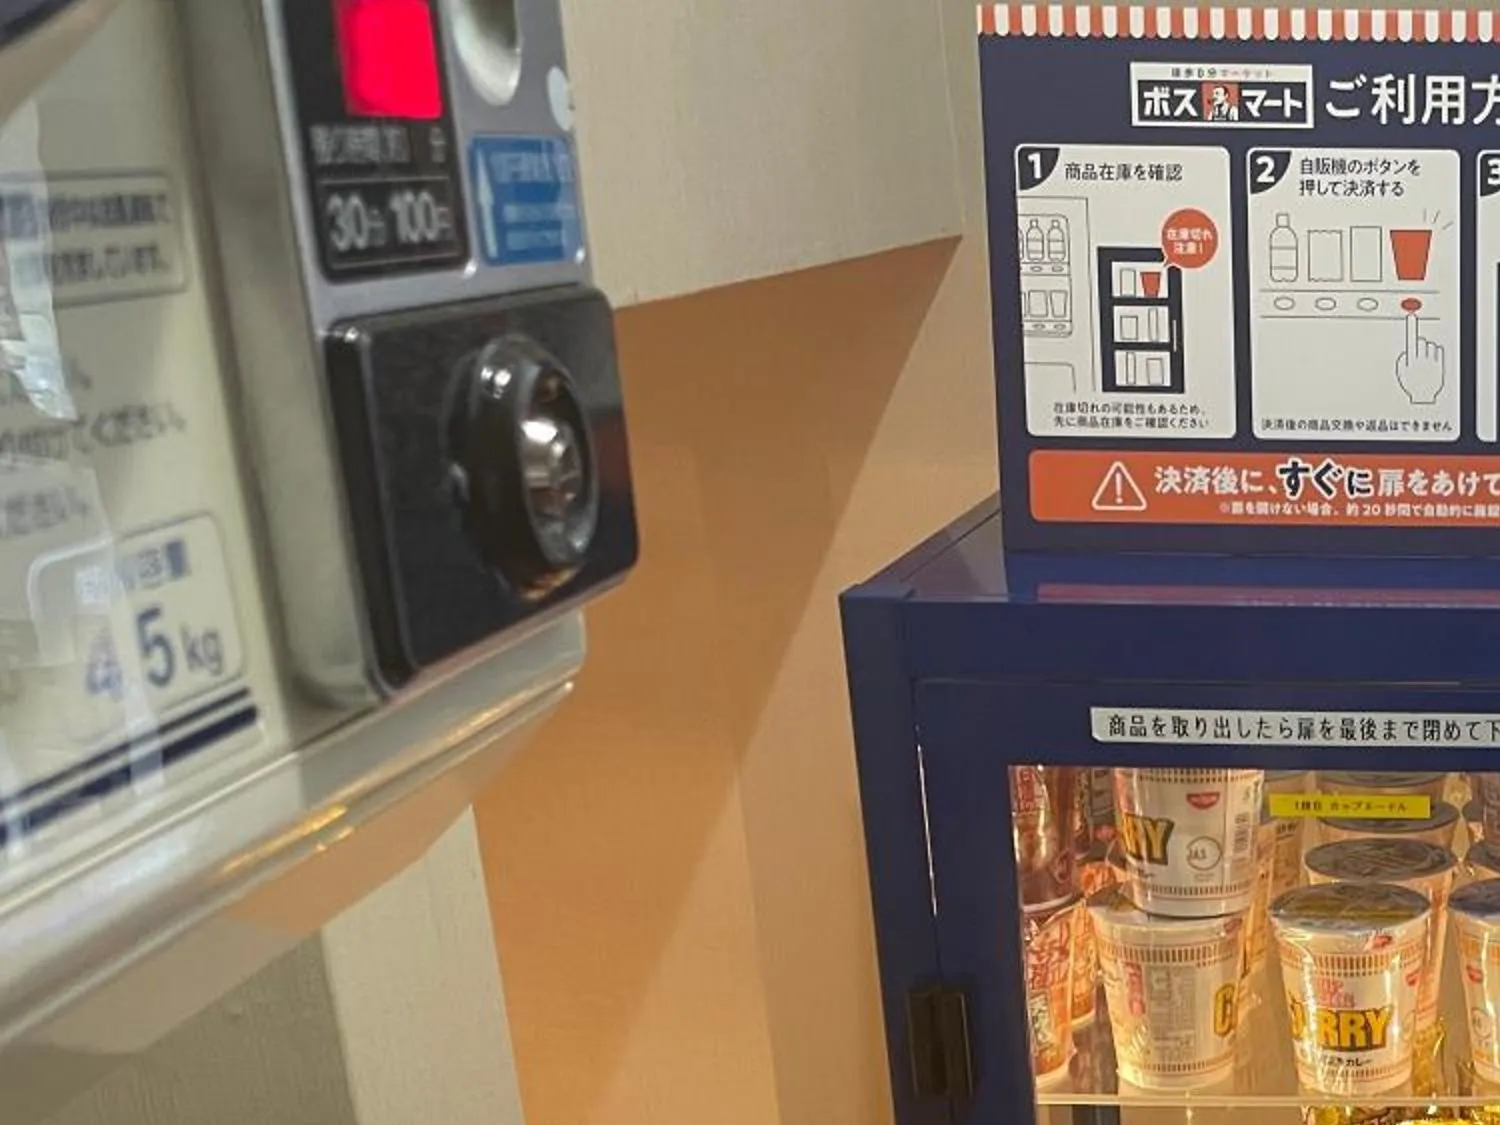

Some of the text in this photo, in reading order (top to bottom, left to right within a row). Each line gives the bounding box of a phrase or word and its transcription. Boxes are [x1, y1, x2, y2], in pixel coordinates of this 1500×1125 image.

[1143, 85, 1304, 118] ボス マート
[1027, 152, 1044, 179] 1
[1065, 162, 1184, 181] 商品在庫を確認
[1256, 156, 1276, 183] 2
[1299, 157, 1421, 176] 自販機のボタンを
[1299, 179, 1405, 198] 押して決済する
